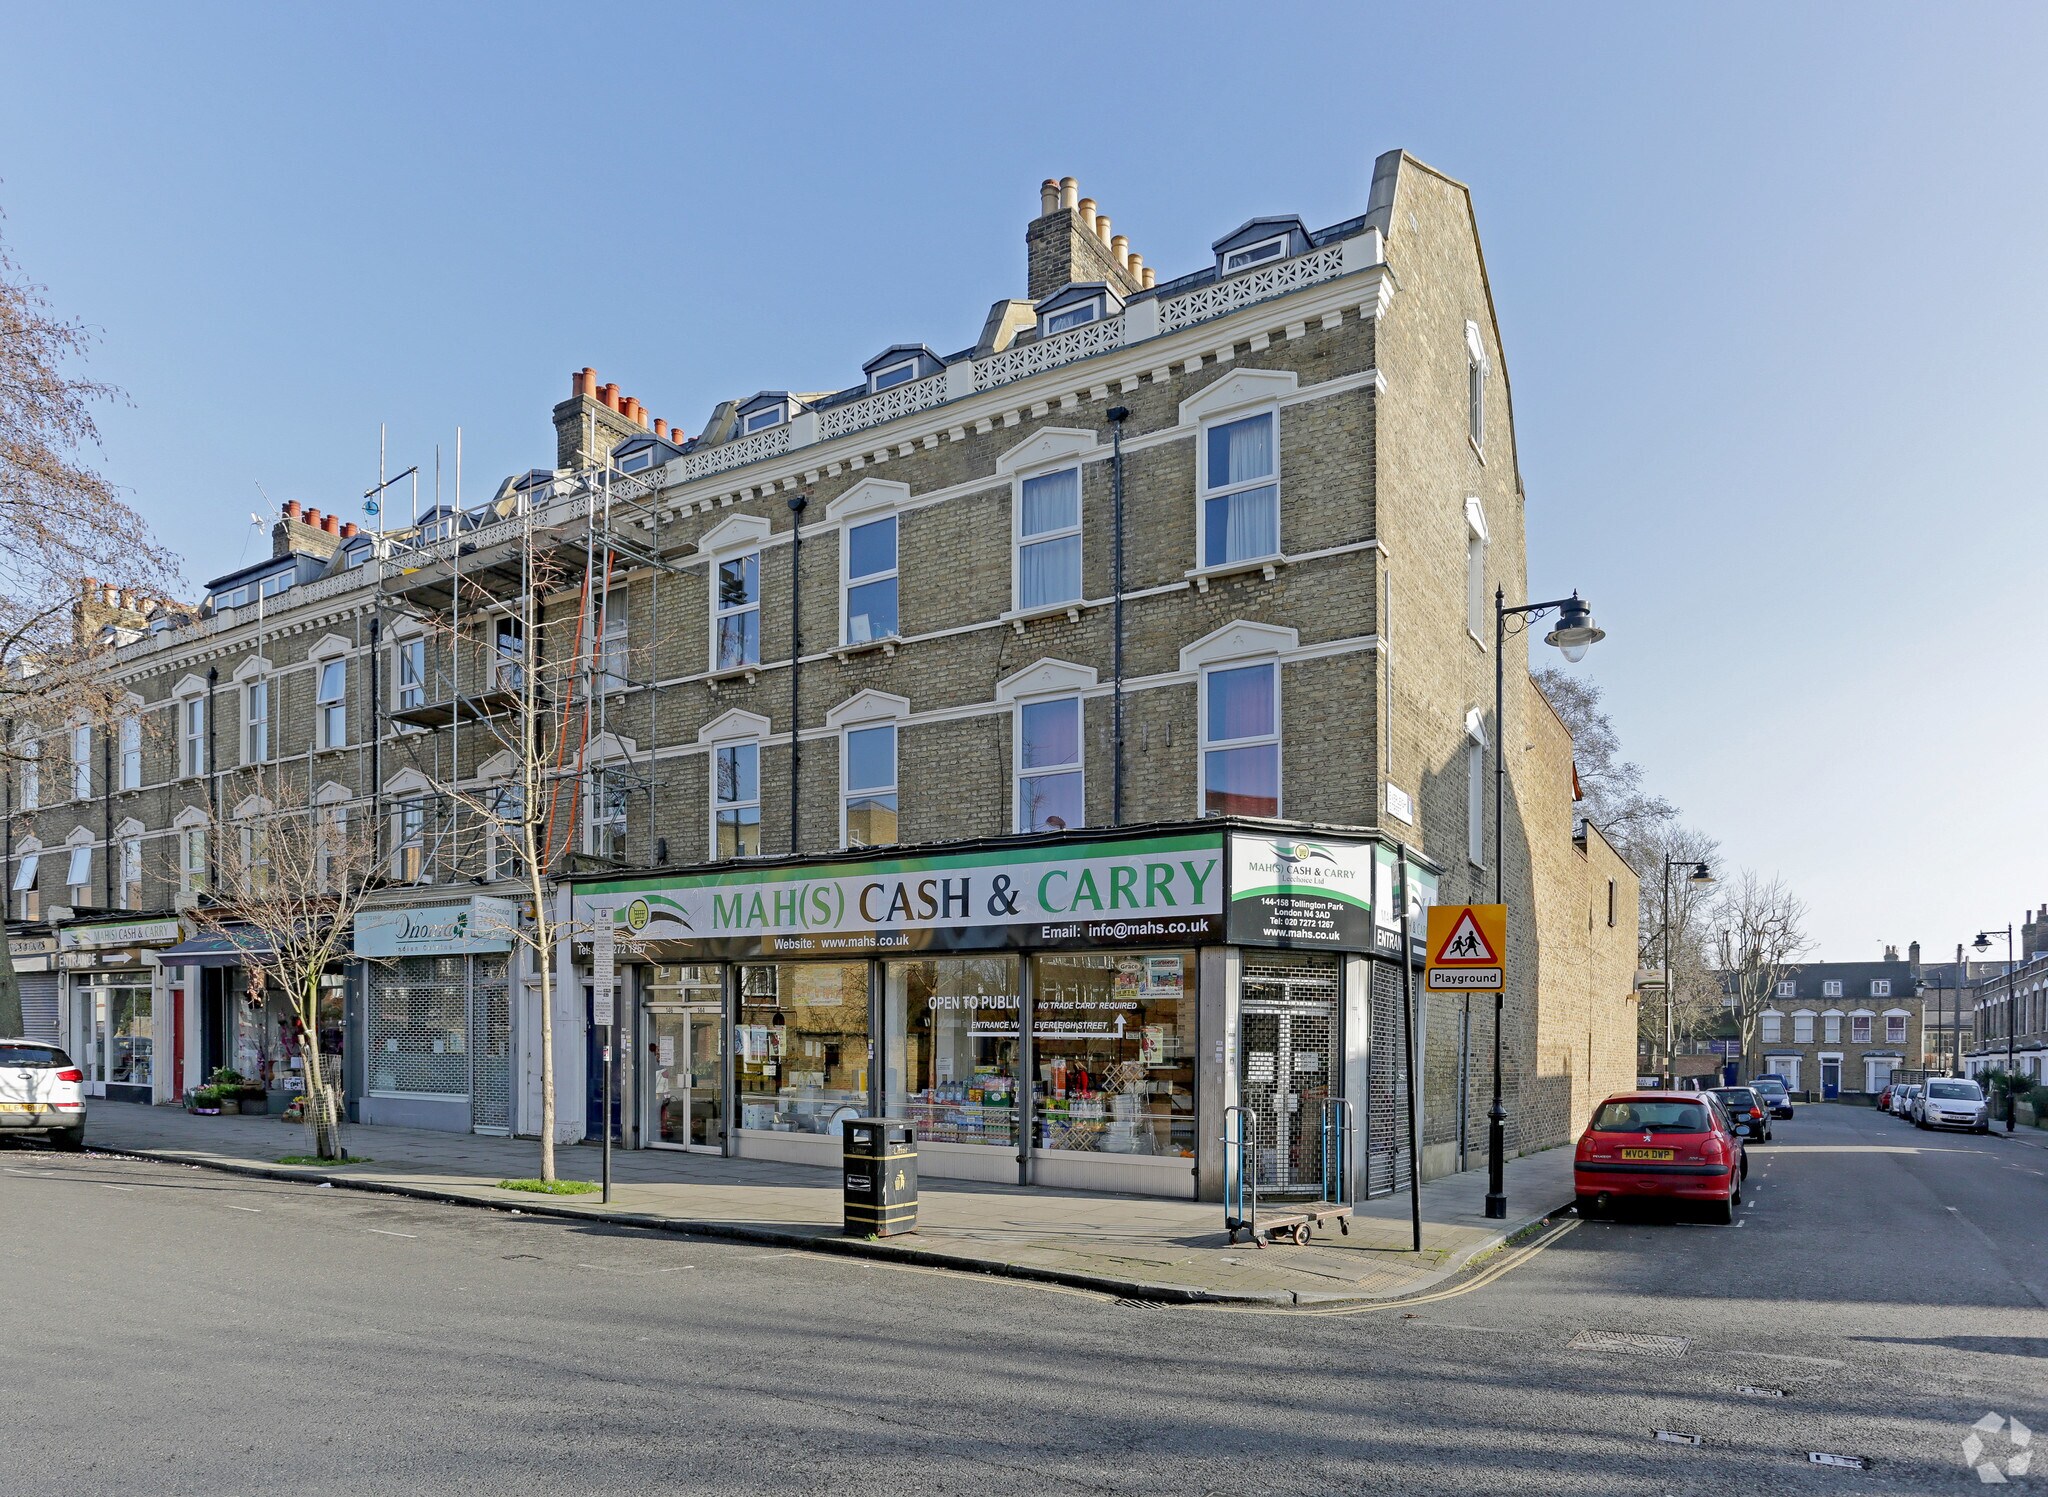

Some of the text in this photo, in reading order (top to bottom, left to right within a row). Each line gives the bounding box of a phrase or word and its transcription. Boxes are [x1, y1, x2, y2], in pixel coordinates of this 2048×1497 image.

[1249, 862, 1356, 879] MAH(S) CASH & CARRY
[713, 859, 1218, 929] MAH(S) CASH & CARRY
[1261, 897, 1344, 911] 144-158 Tollington Park
[1274, 907, 1331, 920] London N4 3AD
[1042, 919, 1209, 939] Email: info@mahs.co.uk
[1269, 917, 1283, 926] Tel:
[1284, 918, 1298, 927] 020
[1299, 919, 1317, 928] 7272
[118, 927, 136, 940] CASH
[144, 925, 169, 937] CARRY
[1263, 928, 1340, 940] www.mahs.co.uk
[774, 933, 909, 950] Website: www.mahs.co.uk
[577, 945, 590, 955] Tel:
[59, 953, 96, 967] ENTRANCE
[1434, 973, 1497, 985] Playground
[928, 996, 960, 1010] OPEN
[962, 996, 977, 1010] TO
[1038, 1002, 1137, 1010] NO TRADE CARD REQUIRED
[971, 1021, 1009, 1029] ENTRANCE
[1034, 1021, 1076, 1030] EVERLEIGH
[1077, 1022, 1108, 1030] STREET
[1625, 1150, 1670, 1158] MV04 DWP
